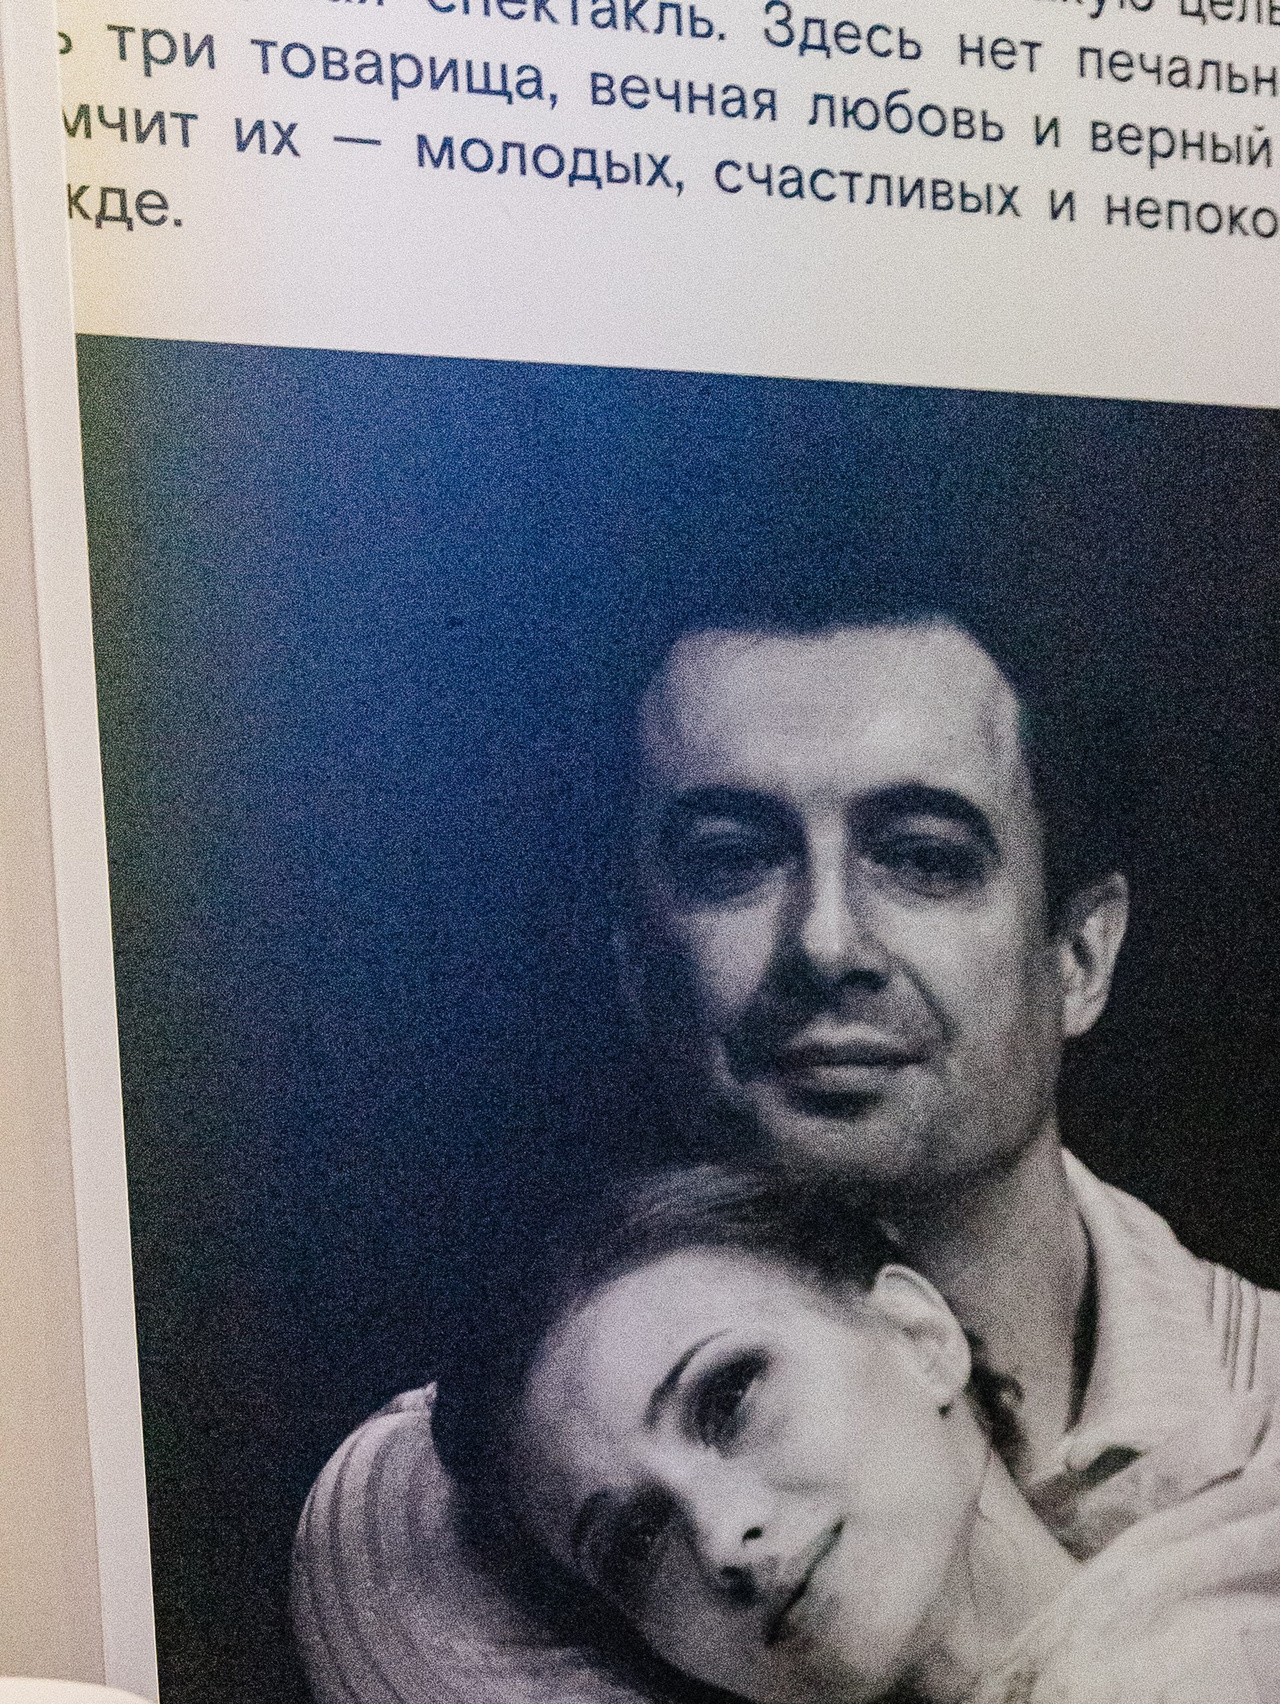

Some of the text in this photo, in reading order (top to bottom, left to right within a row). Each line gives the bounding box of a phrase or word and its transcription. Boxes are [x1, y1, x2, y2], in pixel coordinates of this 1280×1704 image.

[764, 0, 922, 61] Здесь
[959, 34, 1042, 73] нет
[107, 24, 216, 78] три
[250, 39, 558, 109] товарища,
[590, 71, 777, 121] вечная
[808, 88, 1005, 143] любовь
[1034, 115, 1060, 148] и
[1090, 120, 1272, 170] верный
[235, 118, 300, 157] их
[416, 134, 684, 196] молодых,
[714, 159, 1021, 217] счастливых
[1050, 190, 1075, 222] и
